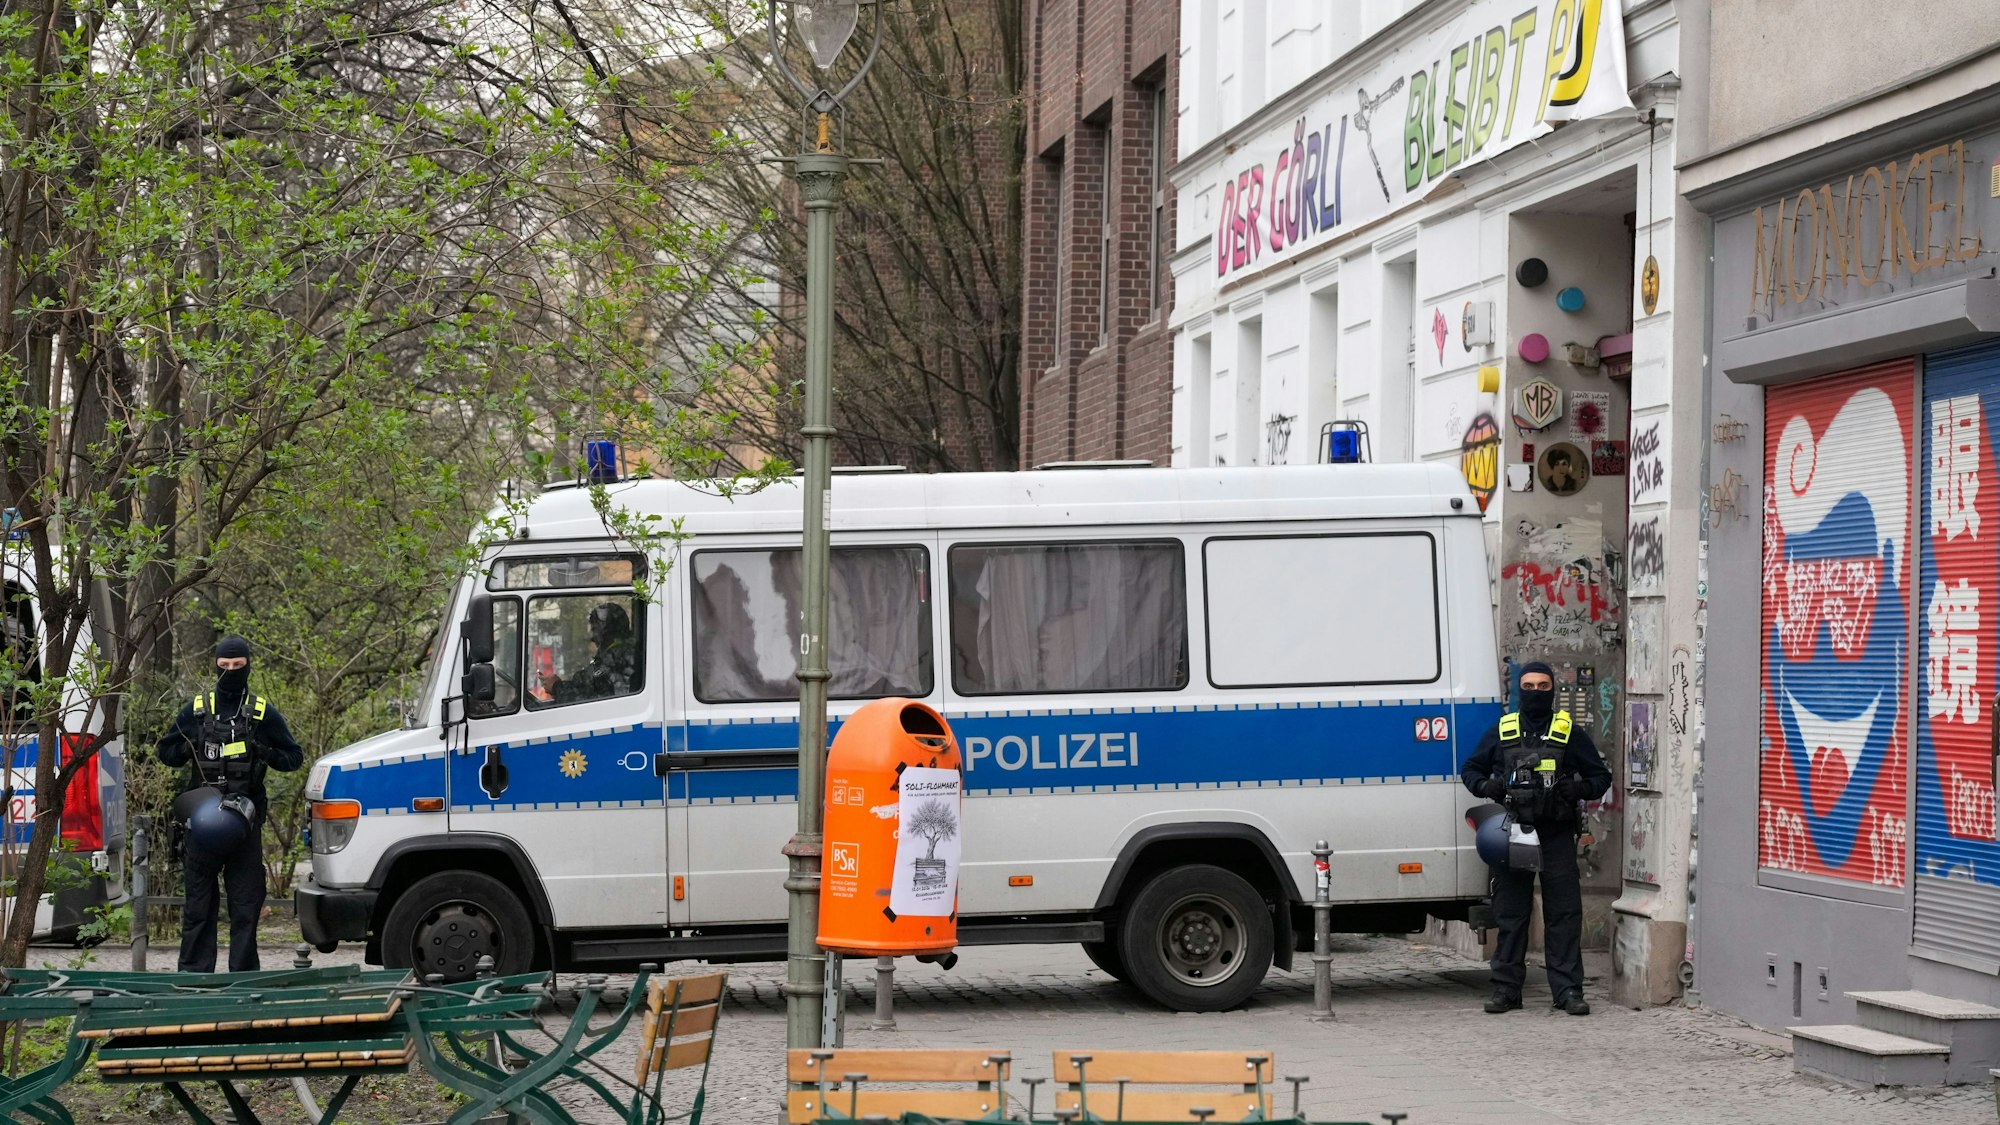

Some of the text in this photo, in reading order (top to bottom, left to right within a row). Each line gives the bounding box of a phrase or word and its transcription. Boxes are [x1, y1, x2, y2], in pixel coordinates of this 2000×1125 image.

[1218, 163, 1264, 278] DER
[1270, 114, 1347, 253] GÖRLI
[1403, 6, 1538, 193] BLEIBT
[1751, 139, 1981, 311] MONOKEL
[1525, 385, 1552, 420] MB
[1416, 718, 1447, 740] 22
[965, 731, 1139, 772] POLIZEI
[833, 848, 856, 872] BSR
